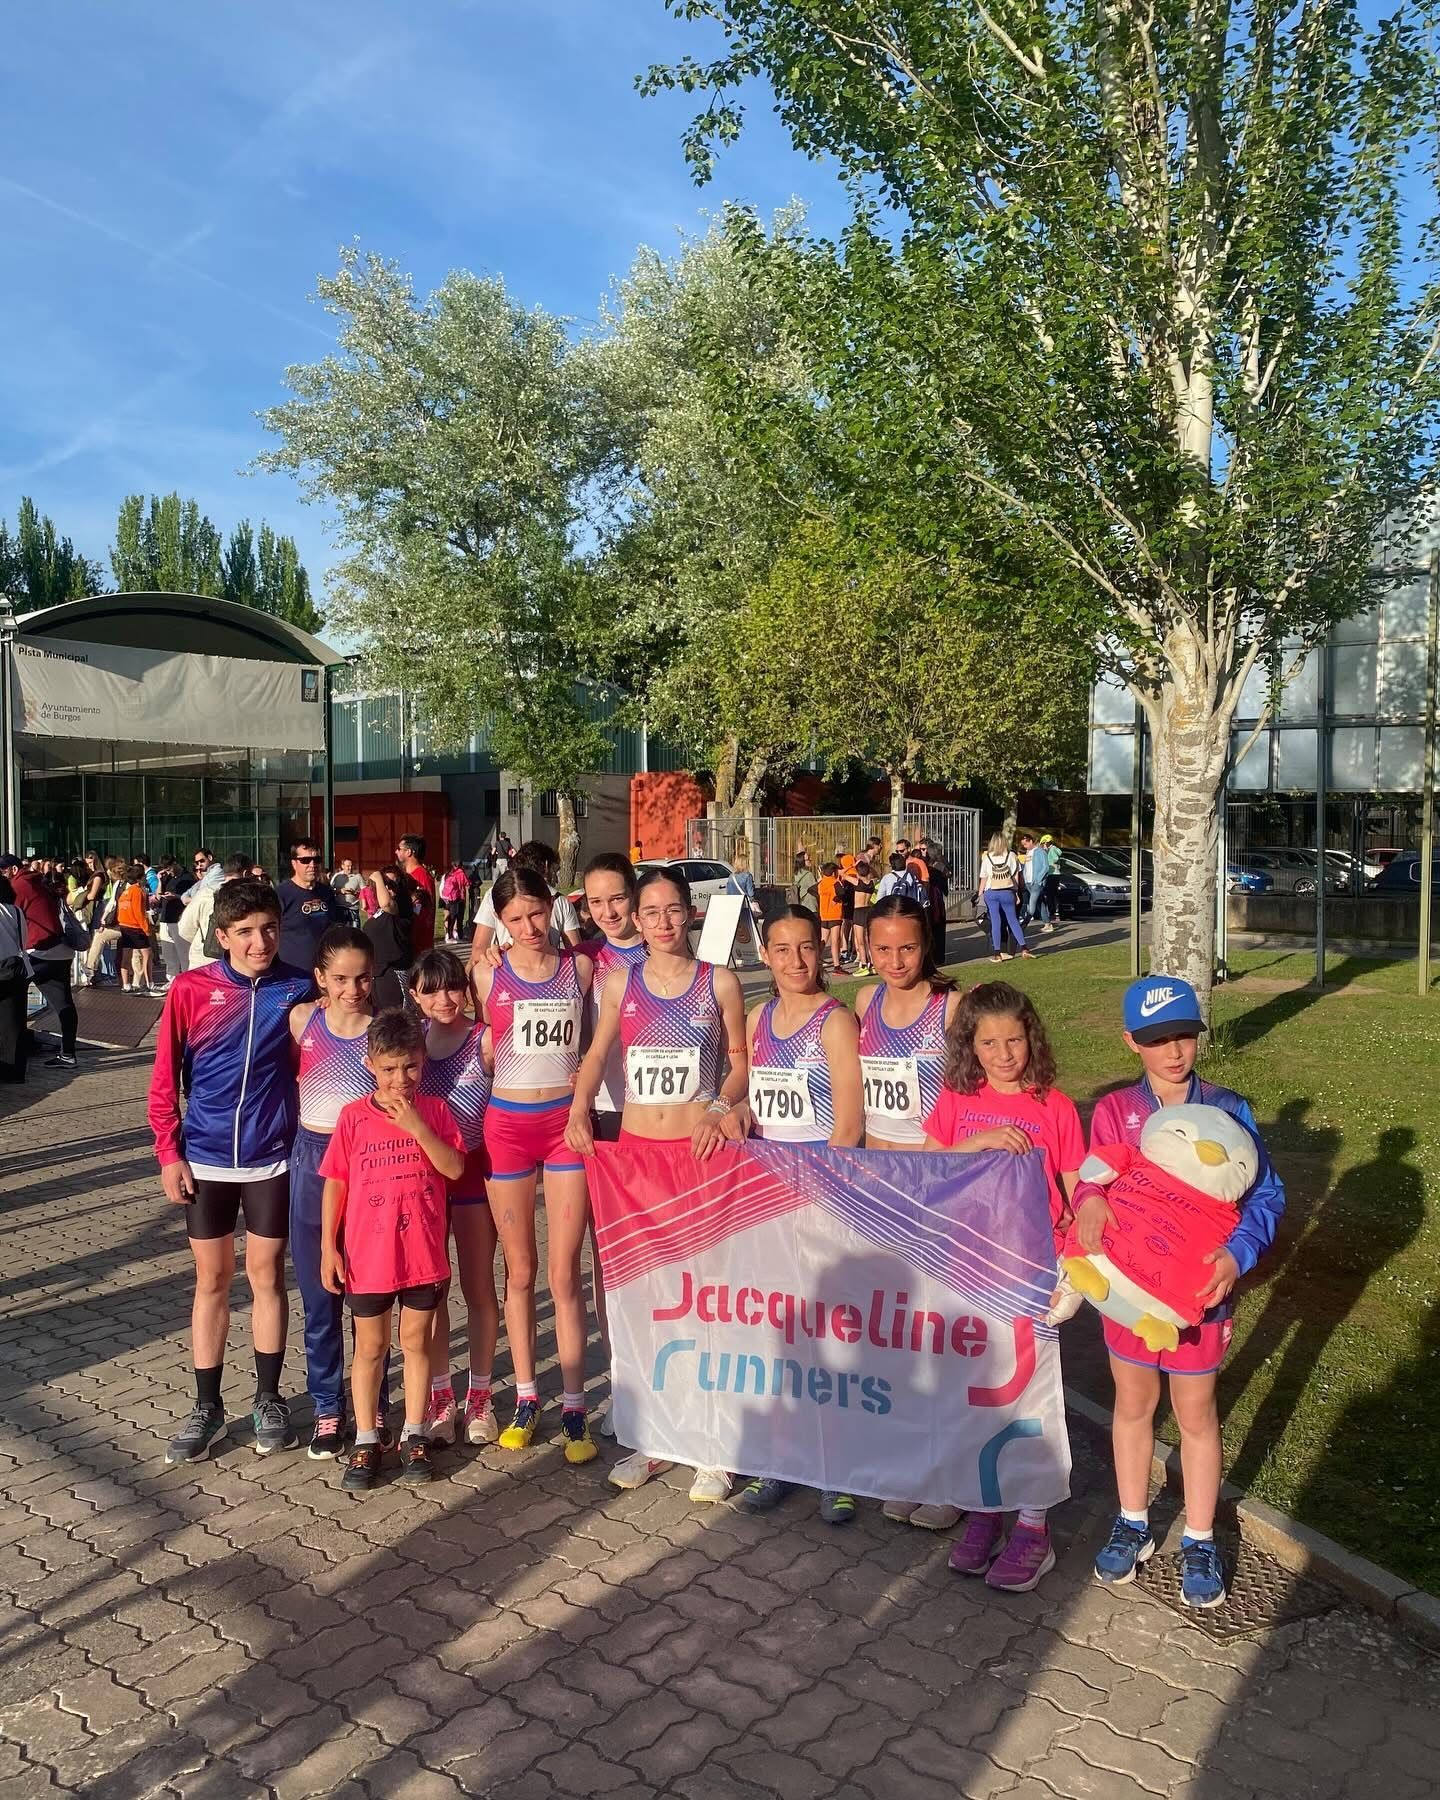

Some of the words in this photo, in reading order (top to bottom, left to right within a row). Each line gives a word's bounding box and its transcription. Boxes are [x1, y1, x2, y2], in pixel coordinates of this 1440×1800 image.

[18, 646, 42, 658] Pista
[43, 650, 89, 664] Municipal
[41, 702, 100, 715] Ayuntamiento
[41, 711, 51, 720] de
[53, 711, 81, 723] Burgos
[1146, 987, 1174, 1006] NIKE
[521, 1020, 574, 1047] 1840
[634, 1066, 690, 1096] 1787
[755, 1089, 804, 1119] 1790
[864, 1077, 910, 1111] 1788
[959, 1109, 1041, 1134] Jacqueline
[360, 1137, 420, 1156] Jacque
[653, 1272, 990, 1358] Jacqueline
